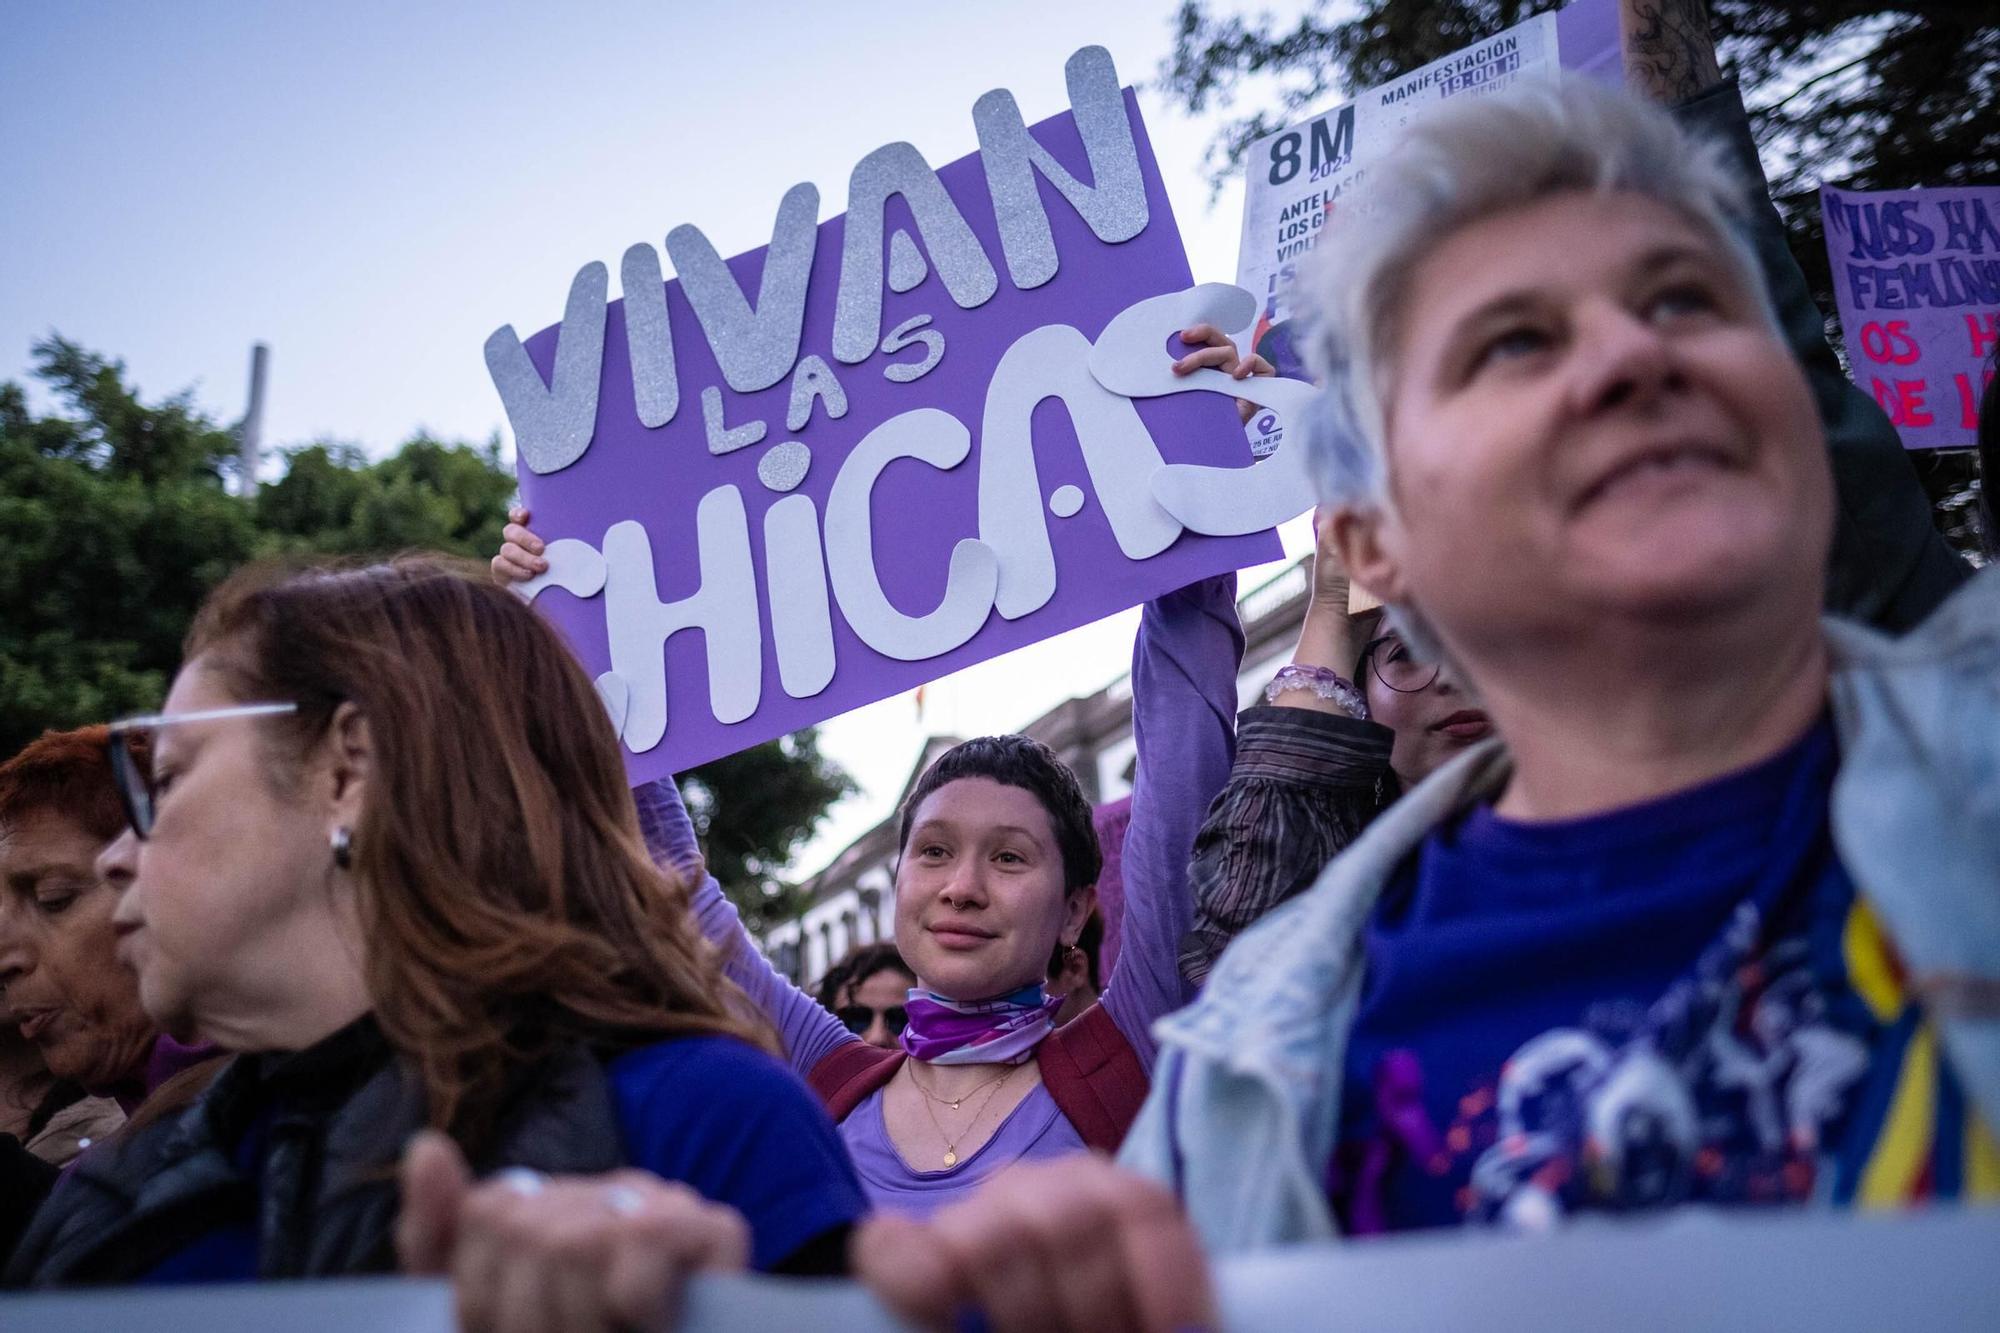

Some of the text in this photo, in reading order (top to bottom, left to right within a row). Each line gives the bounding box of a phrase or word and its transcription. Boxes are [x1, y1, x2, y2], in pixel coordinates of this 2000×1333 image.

[1381, 36, 1517, 106] MANIFESTACIÓN
[1440, 53, 1519, 99] 19:00 H
[1268, 104, 1356, 187] 8M
[1309, 153, 1352, 184] 2024
[1278, 218, 1309, 244] LOS
[1280, 193, 1320, 224] ANTE
[484, 45, 1150, 474] VIVAN
[1861, 321, 1920, 365] OS
[702, 314, 945, 455] LAS
[1871, 377, 1934, 428] DE
